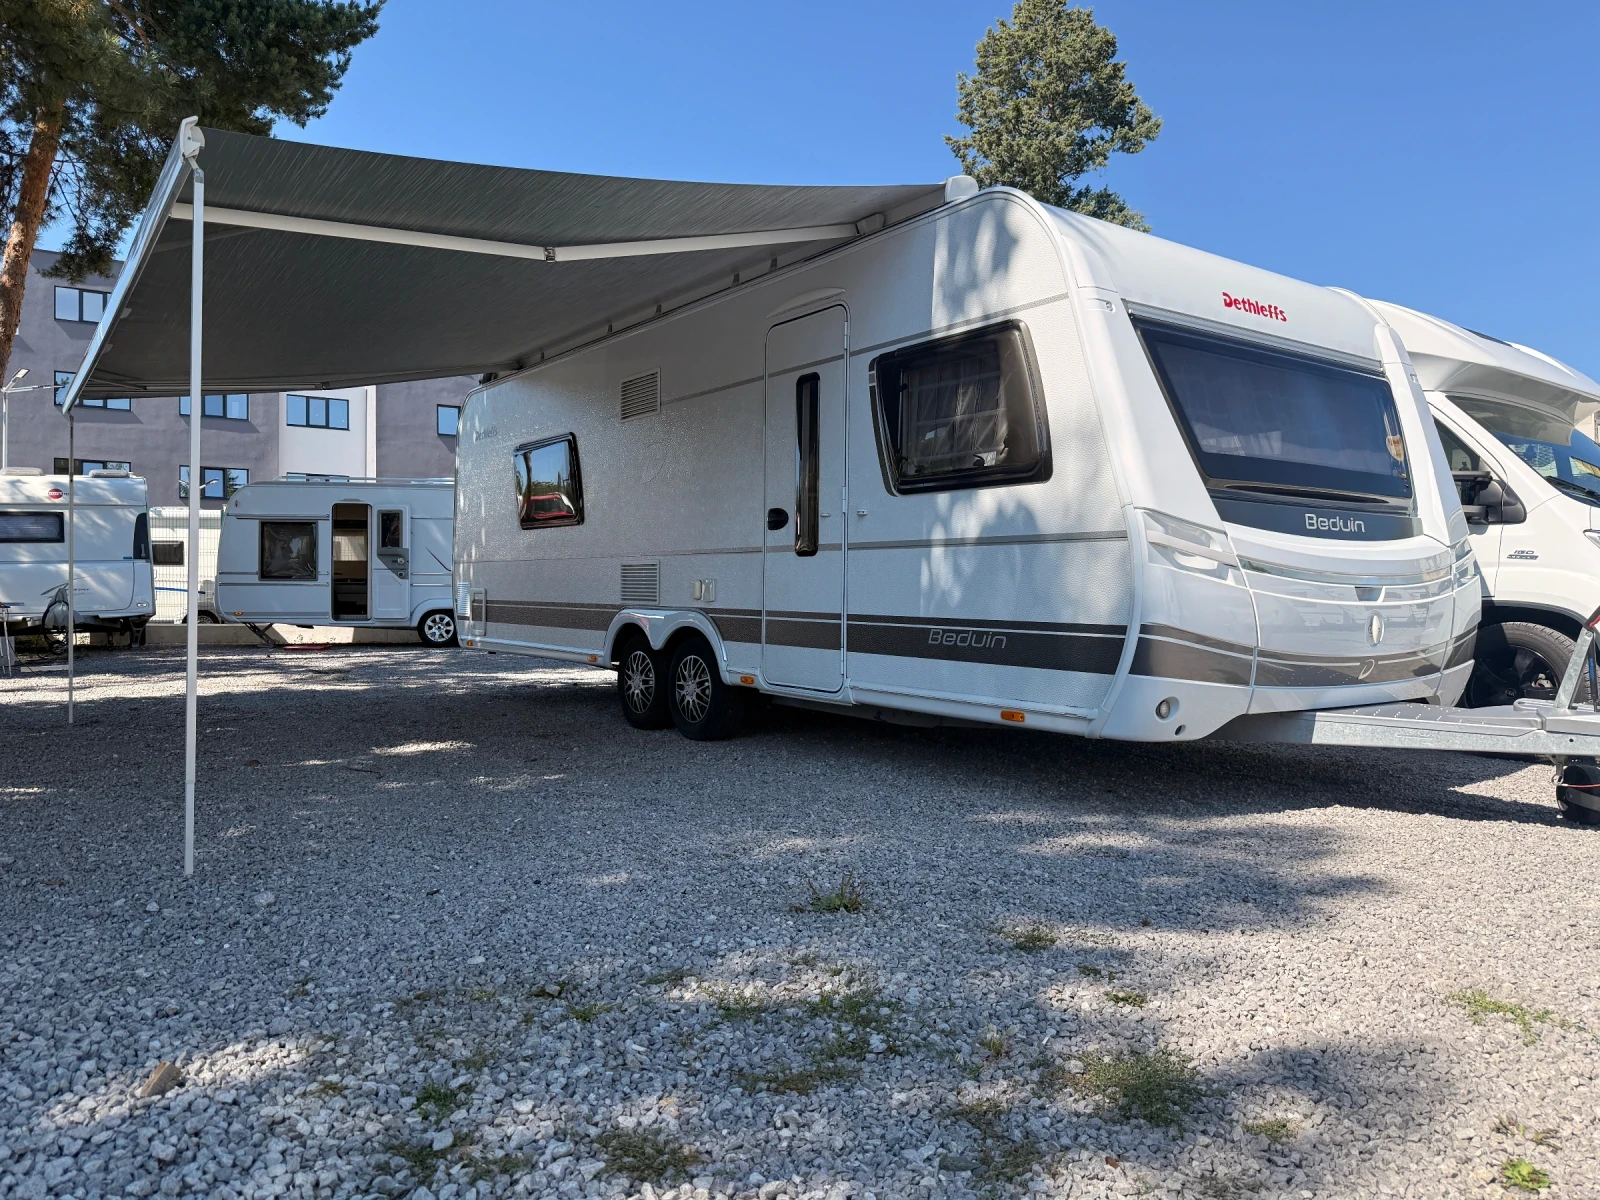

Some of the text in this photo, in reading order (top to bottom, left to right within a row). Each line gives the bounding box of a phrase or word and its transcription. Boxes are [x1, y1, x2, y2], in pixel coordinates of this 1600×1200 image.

[1222, 292, 1287, 322] Dethleffs
[1305, 513, 1365, 533] Beduin
[928, 629, 1007, 649] Beduin
